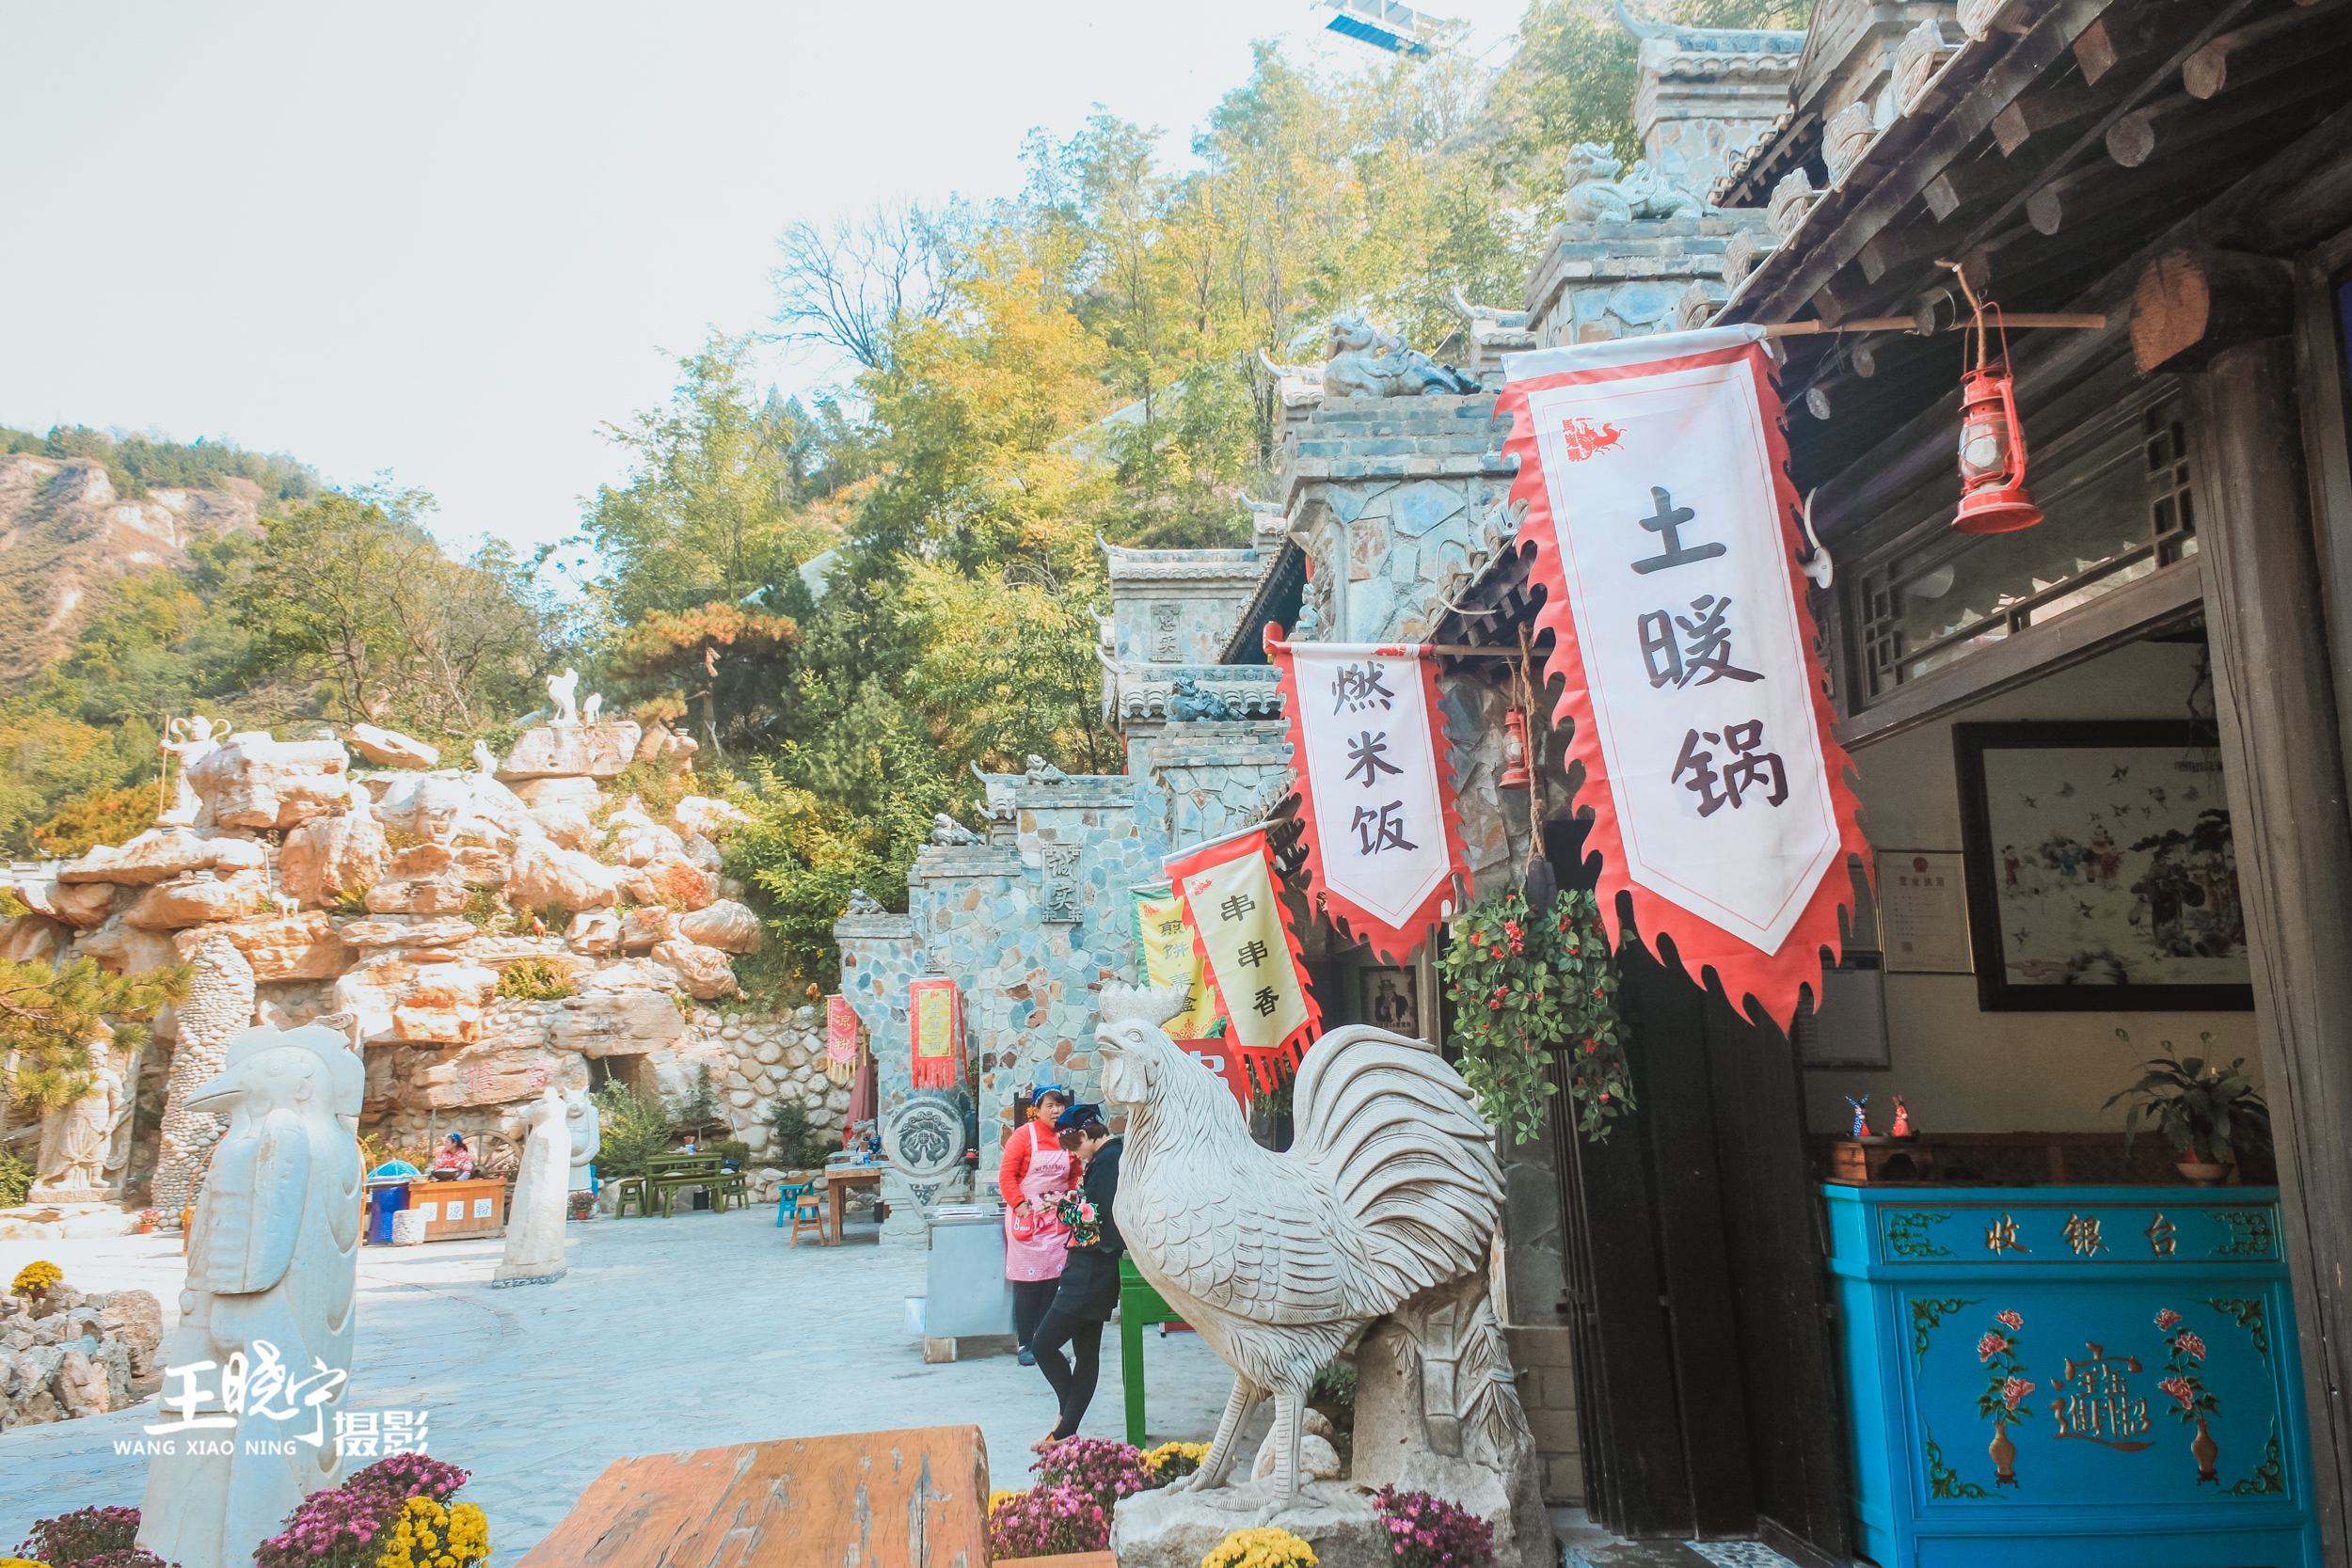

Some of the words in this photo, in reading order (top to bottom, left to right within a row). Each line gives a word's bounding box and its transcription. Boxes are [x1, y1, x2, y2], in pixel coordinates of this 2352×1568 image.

[1630, 485, 1788, 819] 土暖锅
[1332, 660, 1419, 857] 燃米饭
[1220, 893, 1280, 1018] 串串香
[835, 1014, 851, 1051] 凉粉
[1984, 1211, 2177, 1258] 收银台
